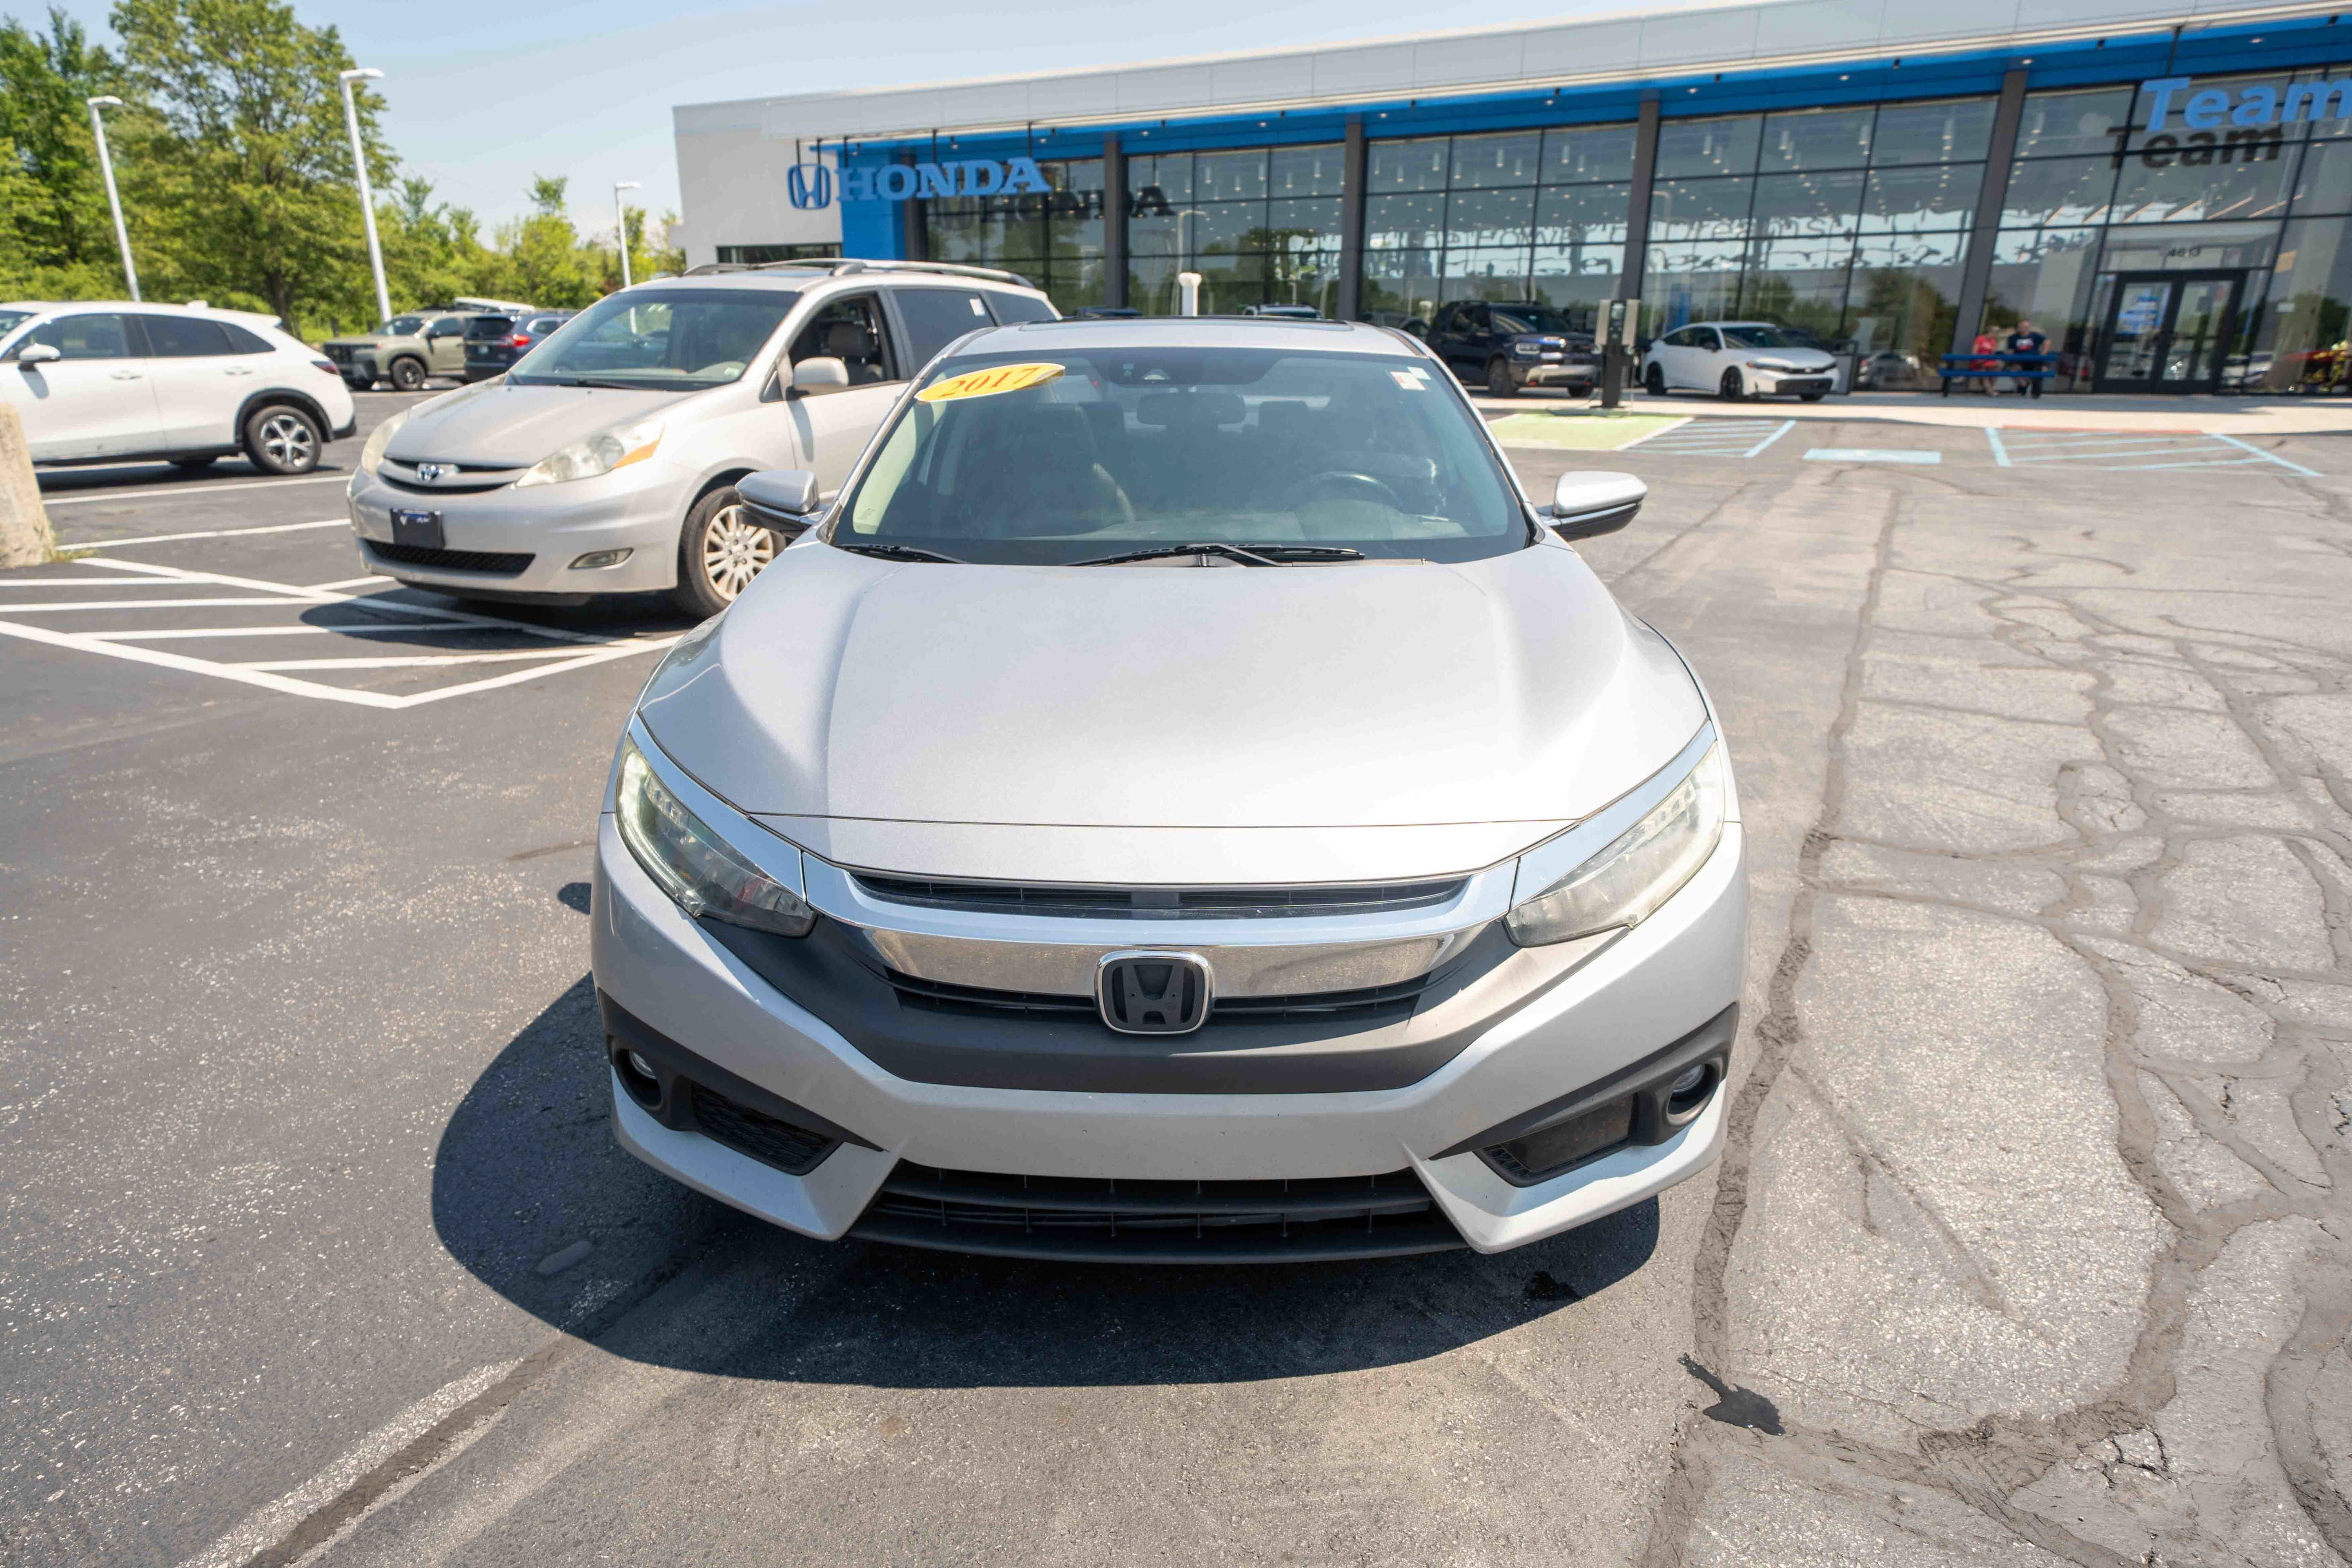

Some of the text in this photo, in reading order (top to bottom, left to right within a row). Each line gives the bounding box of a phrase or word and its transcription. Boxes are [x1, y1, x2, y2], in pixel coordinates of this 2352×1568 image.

[2143, 76, 2352, 133] Team
[835, 156, 1052, 202] HONDA
[939, 367, 1040, 398] 2017
